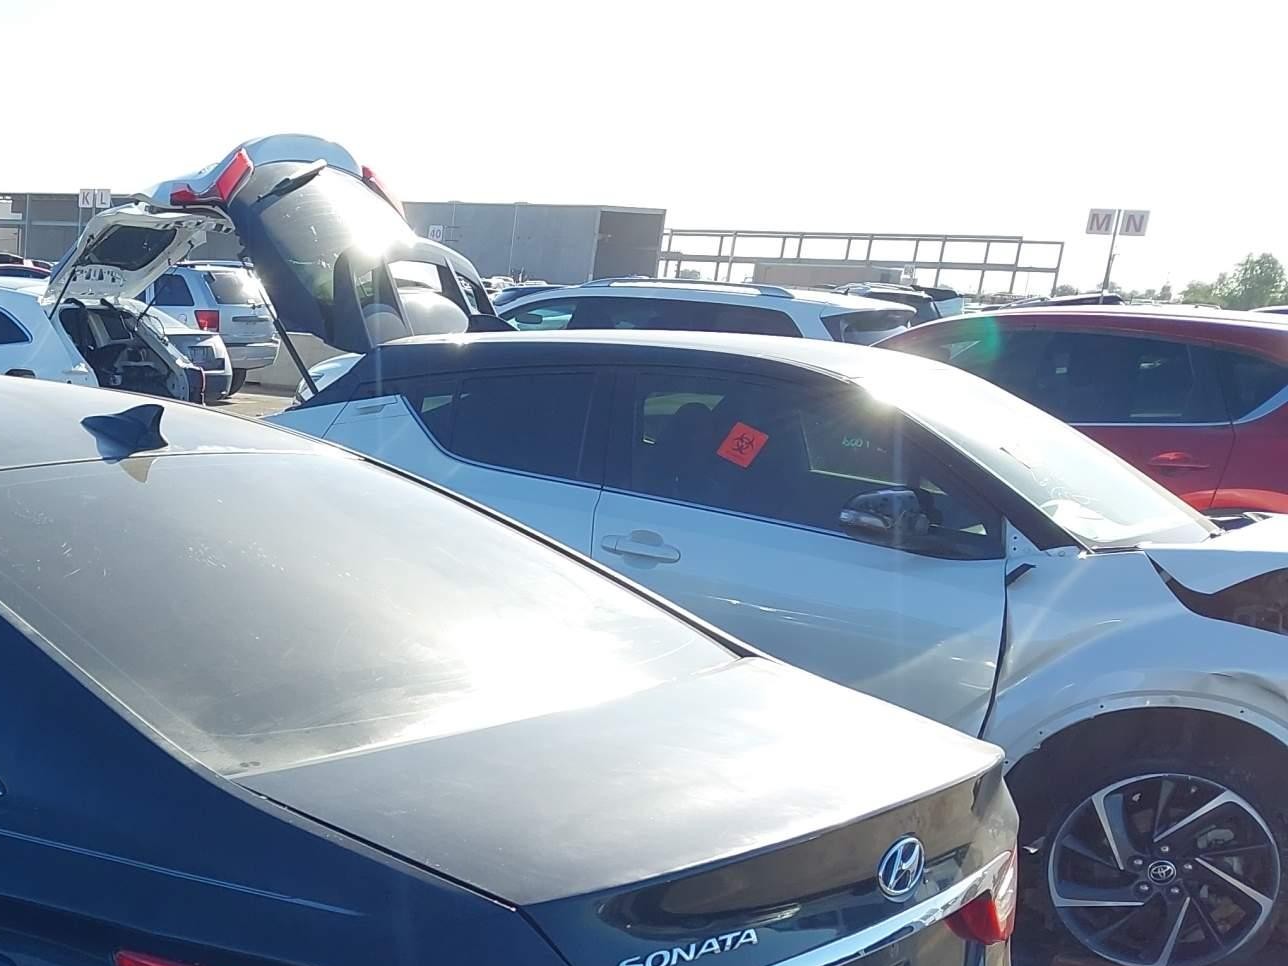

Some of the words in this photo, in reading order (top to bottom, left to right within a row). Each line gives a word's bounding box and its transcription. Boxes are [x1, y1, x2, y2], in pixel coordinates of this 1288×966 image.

[82, 191, 90, 205] K
[100, 191, 107, 205] L
[1089, 213, 1112, 232] M
[1125, 213, 1145, 233] N
